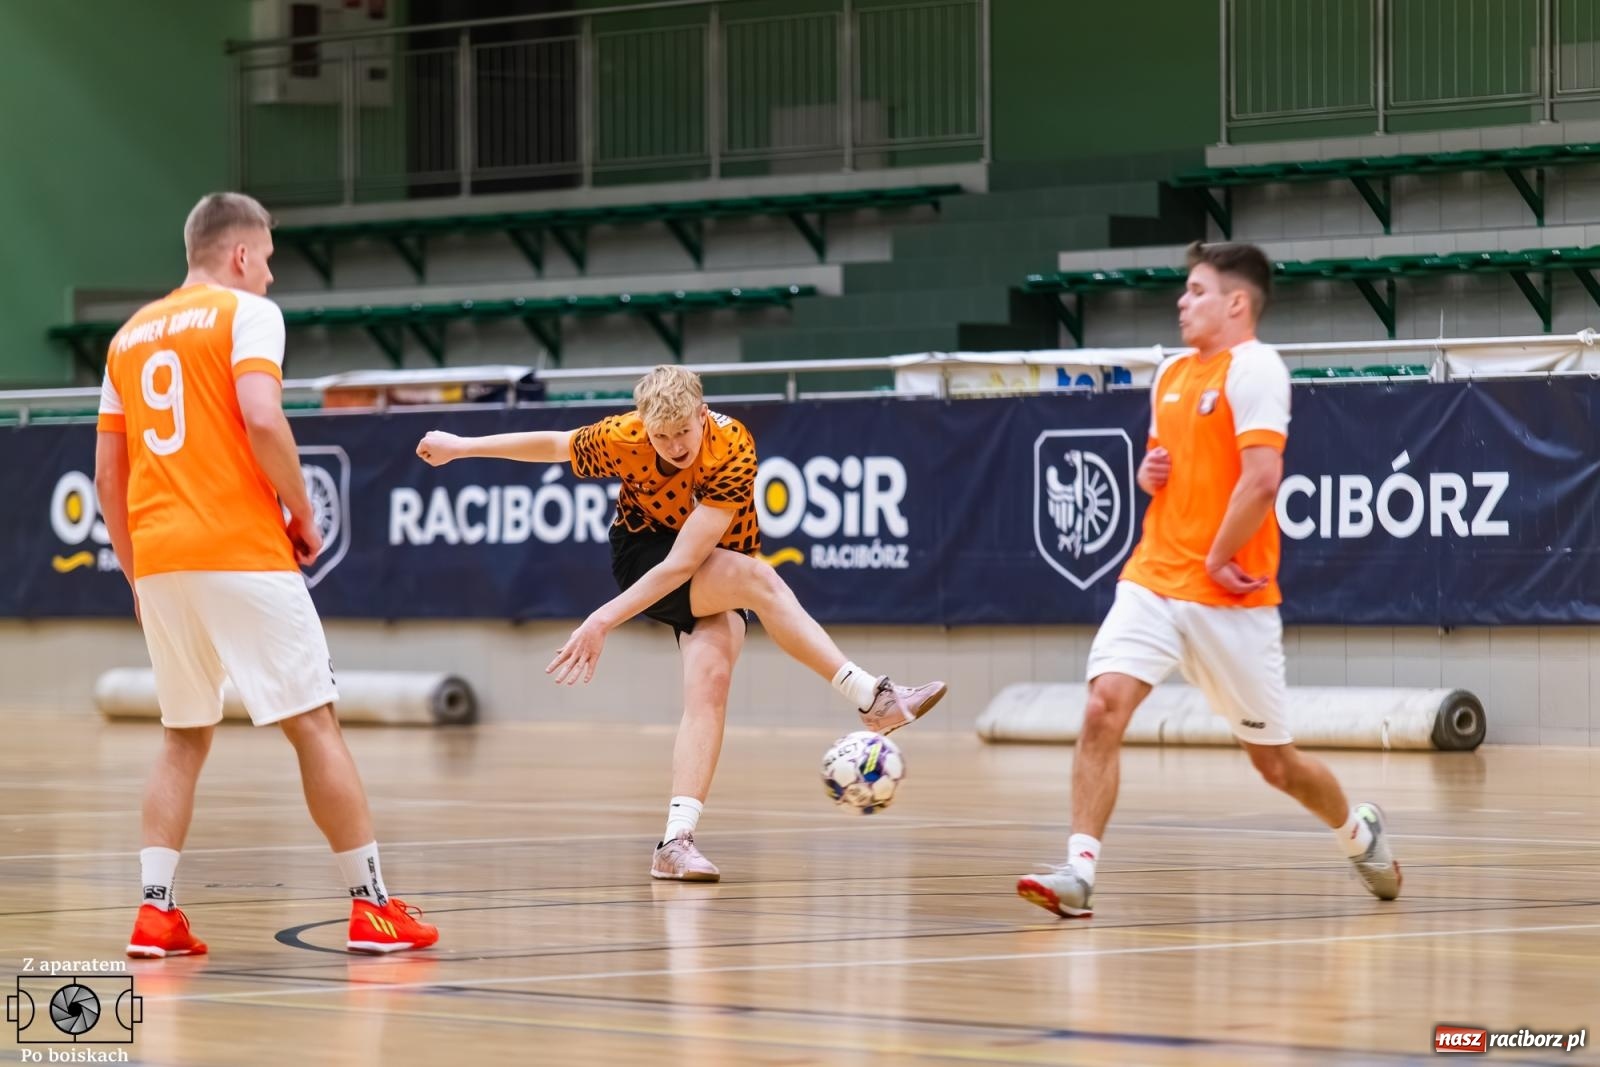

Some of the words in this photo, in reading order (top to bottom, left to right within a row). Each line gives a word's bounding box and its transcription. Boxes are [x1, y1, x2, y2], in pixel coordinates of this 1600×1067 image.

[141, 349, 186, 456] 9
[754, 455, 909, 539] OSiR
[1274, 449, 1510, 540] CIBÓRZ
[811, 538, 909, 569] RACIBÓRZ
